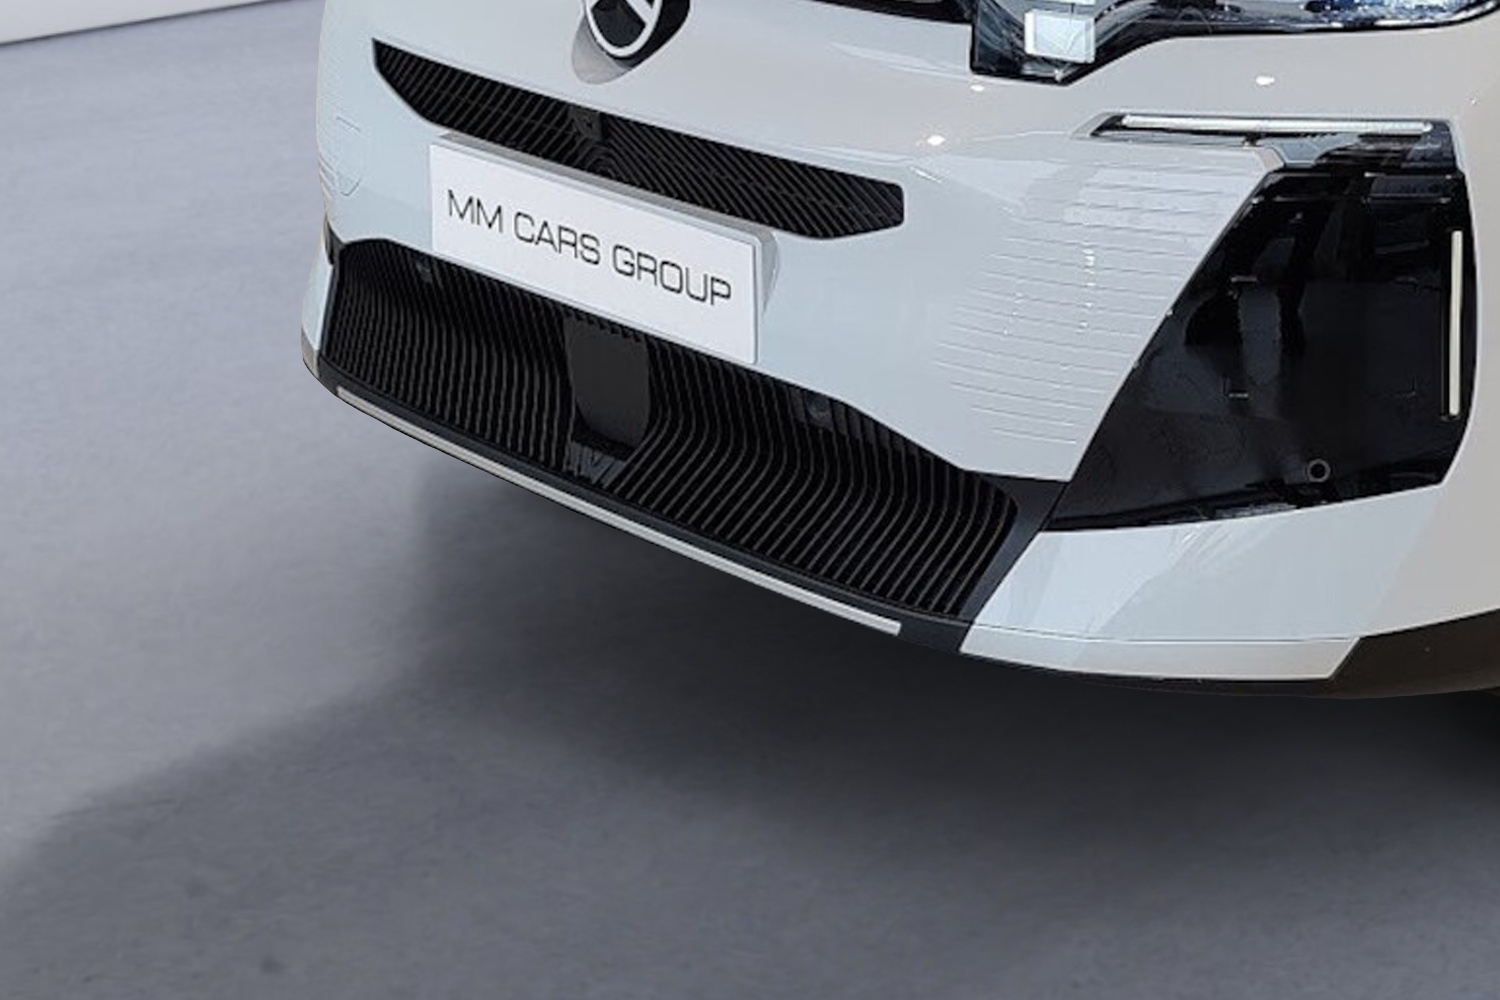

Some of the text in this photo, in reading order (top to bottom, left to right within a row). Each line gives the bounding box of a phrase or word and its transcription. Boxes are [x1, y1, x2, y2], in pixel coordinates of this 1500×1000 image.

[447, 188, 731, 306] MM CARS GROUP
